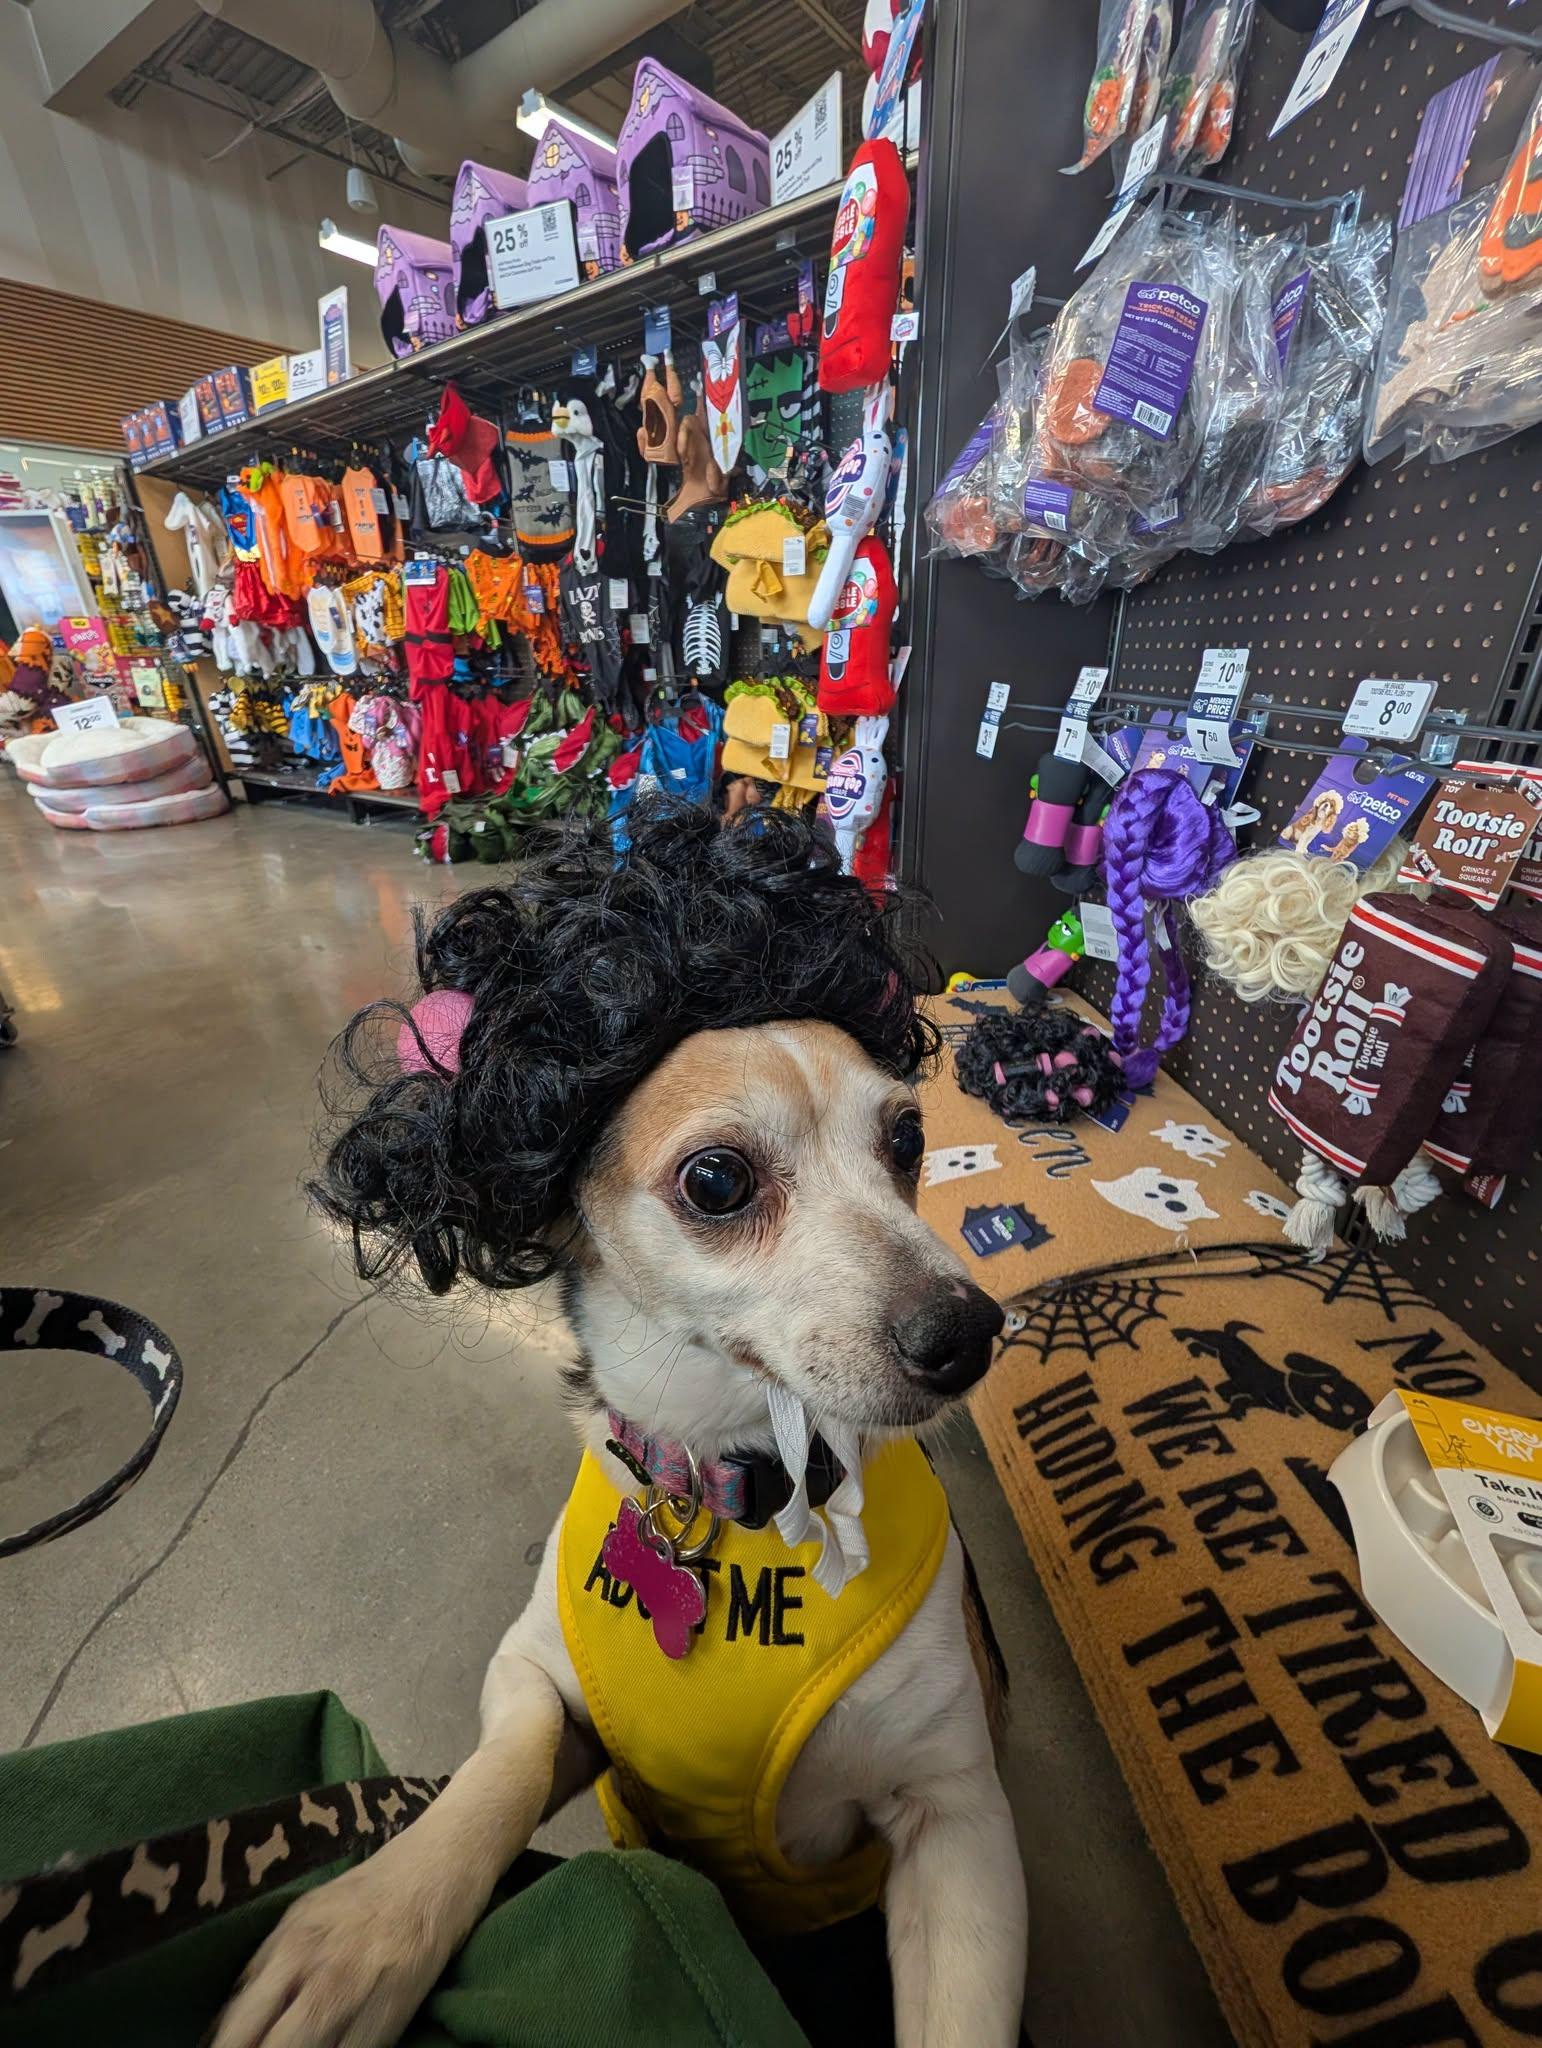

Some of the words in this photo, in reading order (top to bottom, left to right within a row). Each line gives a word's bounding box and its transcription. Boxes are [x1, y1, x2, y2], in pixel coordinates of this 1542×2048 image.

[776, 139, 793, 178] 25
[493, 228, 516, 254] 25
[1138, 302, 1163, 311] TRICK
[1164, 306, 1175, 314] OR
[1176, 310, 1198, 326] TREAT
[1158, 290, 1201, 314] petco
[292, 362, 306, 378] 25
[568, 582, 601, 606] LAZY
[1218, 662, 1235, 683] 10
[1085, 680, 1096, 695] 10
[1073, 708, 1089, 717] PRICE
[1206, 704, 1231, 716] PRICE
[1210, 697, 1233, 706] MEMBER
[1379, 700, 1397, 725] 8
[1396, 702, 1412, 715] 00
[73, 717, 92, 731] 12
[1063, 728, 1073, 749] 7
[1112, 736, 1127, 761] petco
[1197, 729, 1208, 752] 7
[1208, 731, 1218, 742] 50
[1404, 770, 1426, 785] LG/XL
[1444, 785, 1461, 794] TOY
[1360, 796, 1401, 820] petco
[1433, 800, 1525, 839] Tootsie
[1432, 827, 1492, 860] Roll
[1458, 873, 1493, 885] SQUEAKS!
[1460, 865, 1490, 876] CRINCLE
[1276, 941, 1365, 1094] Tootsie
[1309, 990, 1375, 1095] Roll
[1355, 1026, 1380, 1070] Tootsie
[1370, 1041, 1390, 1068] Roll
[1355, 1328, 1486, 1398] NO
[1485, 1436, 1535, 1463] YAY
[1474, 1473, 1528, 1499] Take
[1013, 1372, 1177, 1586] HIDING
[1122, 1587, 1301, 1805] THE
[725, 1564, 806, 1647] ME
[1244, 1571, 1531, 1884] TIRED
